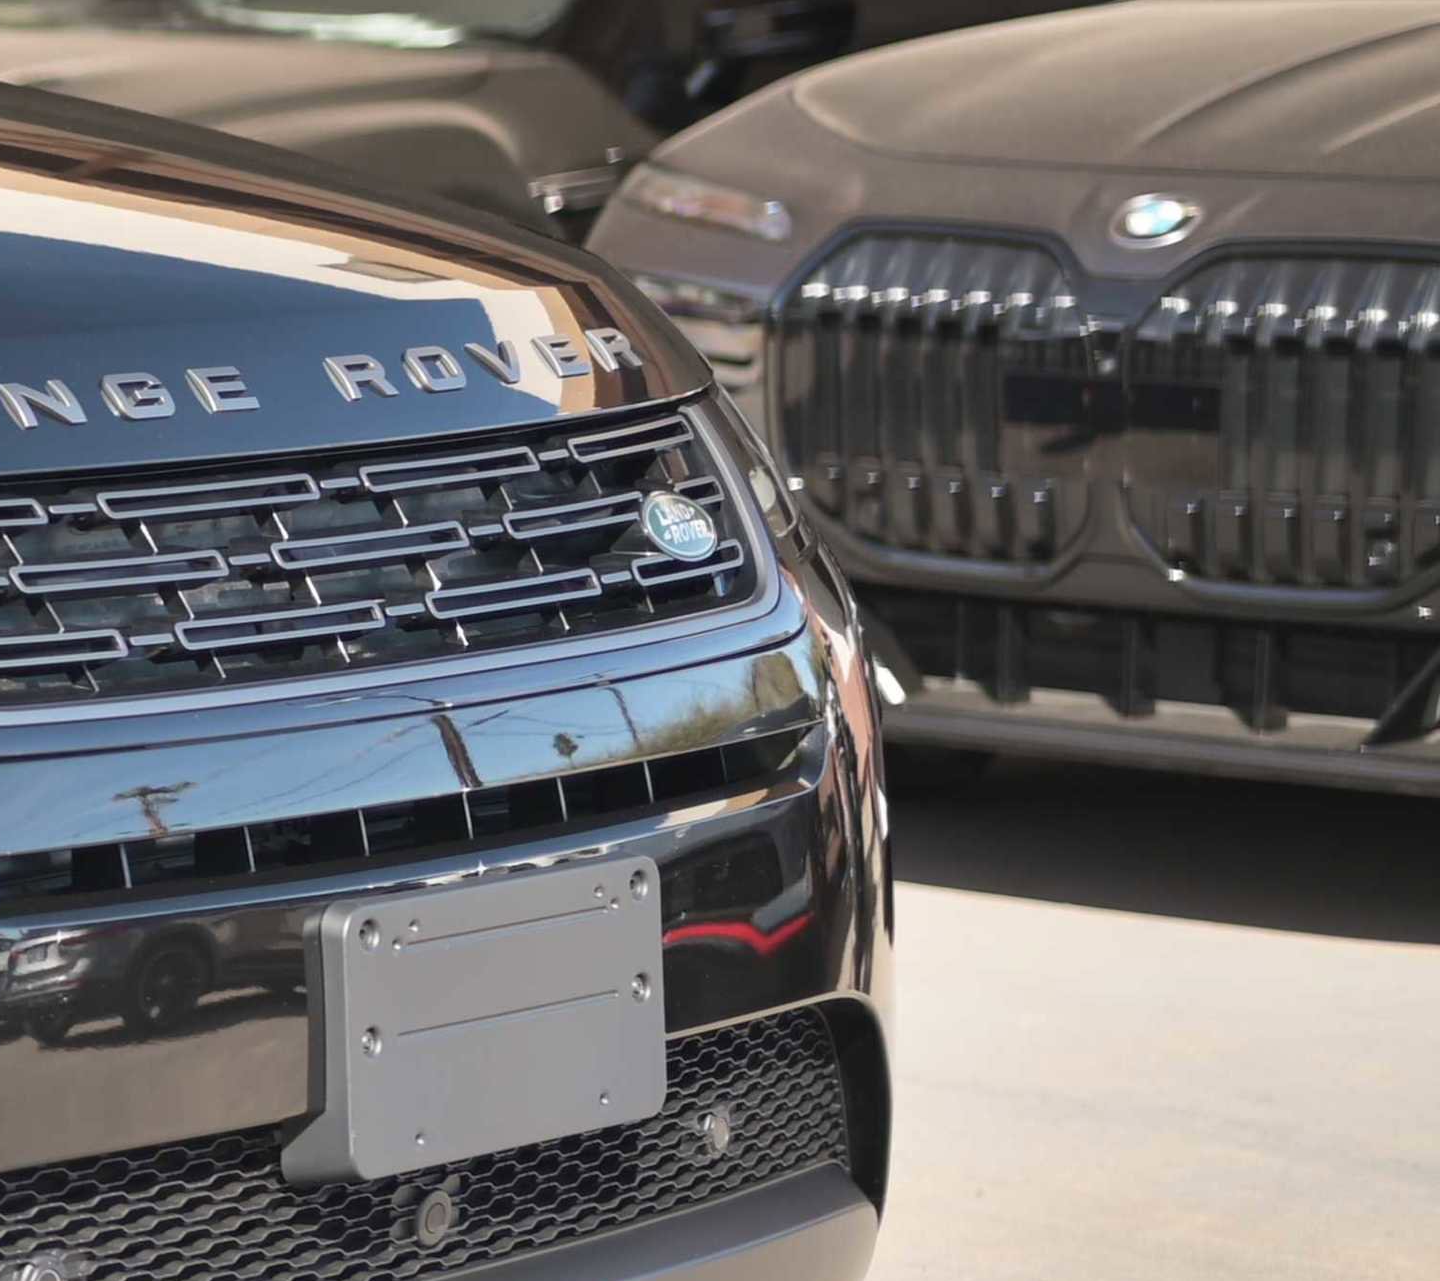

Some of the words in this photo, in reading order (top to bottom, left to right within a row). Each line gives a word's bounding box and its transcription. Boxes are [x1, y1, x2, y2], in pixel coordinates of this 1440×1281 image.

[323, 325, 643, 403] ROVER
[655, 502, 690, 526] LAND
[670, 518, 715, 545] ROVER
